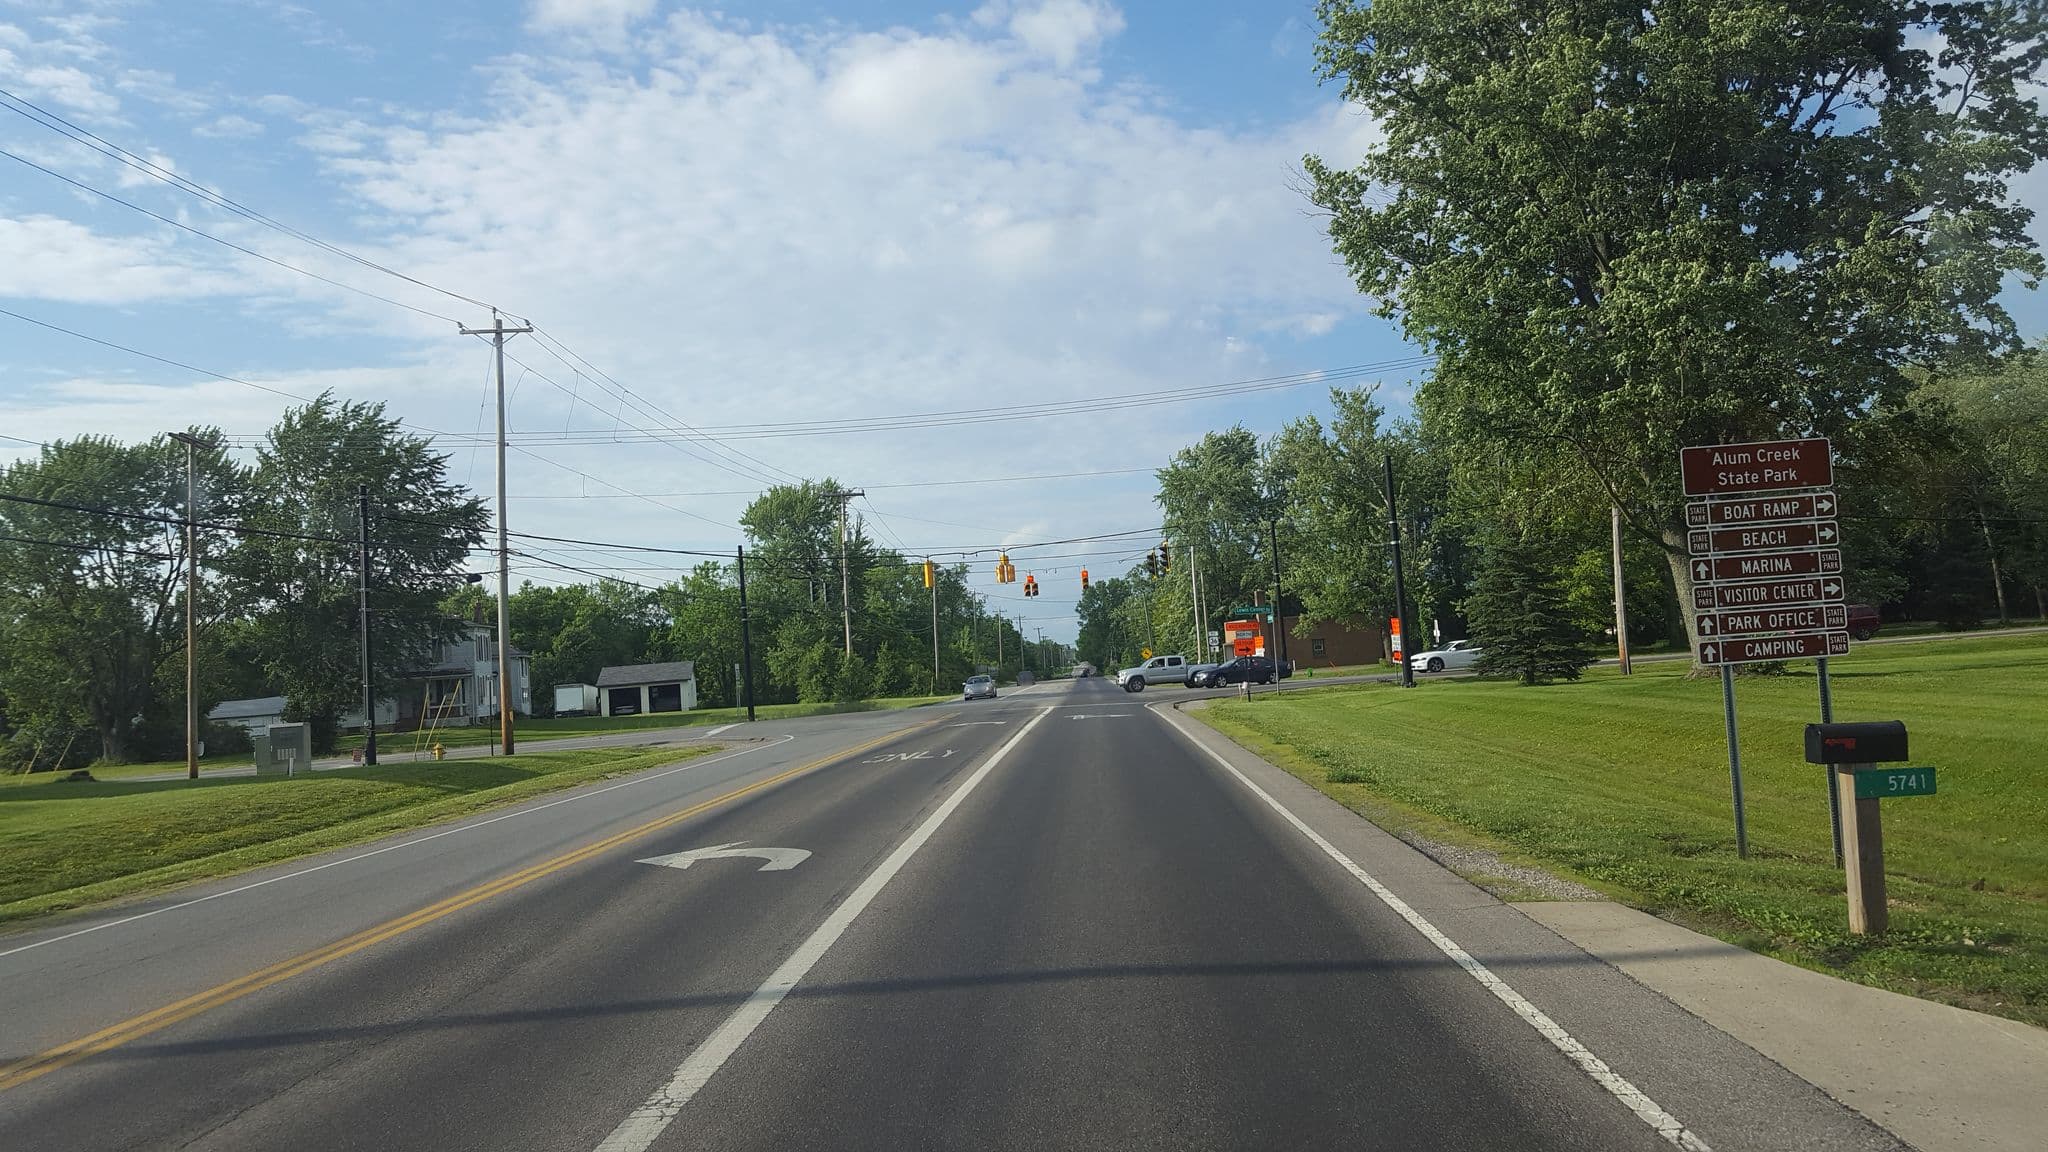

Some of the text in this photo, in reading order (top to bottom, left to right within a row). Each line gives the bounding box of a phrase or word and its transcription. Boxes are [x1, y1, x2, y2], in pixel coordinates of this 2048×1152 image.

[1712, 448, 1800, 466] Alum Creek
[1718, 468, 1797, 486] State Park
[1690, 506, 1706, 515] STATE
[1724, 501, 1800, 520] BOAT RAMP
[1691, 514, 1707, 522] PARK
[1692, 534, 1708, 543] STATE
[1743, 530, 1786, 546] BEACH
[1694, 542, 1709, 550] PARK
[1822, 553, 1838, 562] STATE
[1742, 558, 1792, 574] MARINA
[1823, 561, 1839, 569] PARK
[1696, 590, 1713, 598] STATE
[1724, 583, 1814, 602] VISITOR CENTER
[1698, 597, 1714, 605] PARK
[1826, 609, 1843, 617] STATE
[1728, 612, 1815, 630] PARK OFFICE
[1828, 616, 1844, 625] PARK
[1830, 636, 1846, 644] STATE
[1745, 640, 1804, 656] CAMPING
[1832, 643, 1847, 652] PARK
[862, 749, 960, 764] ONLY
[1888, 774, 1926, 791] 5741
